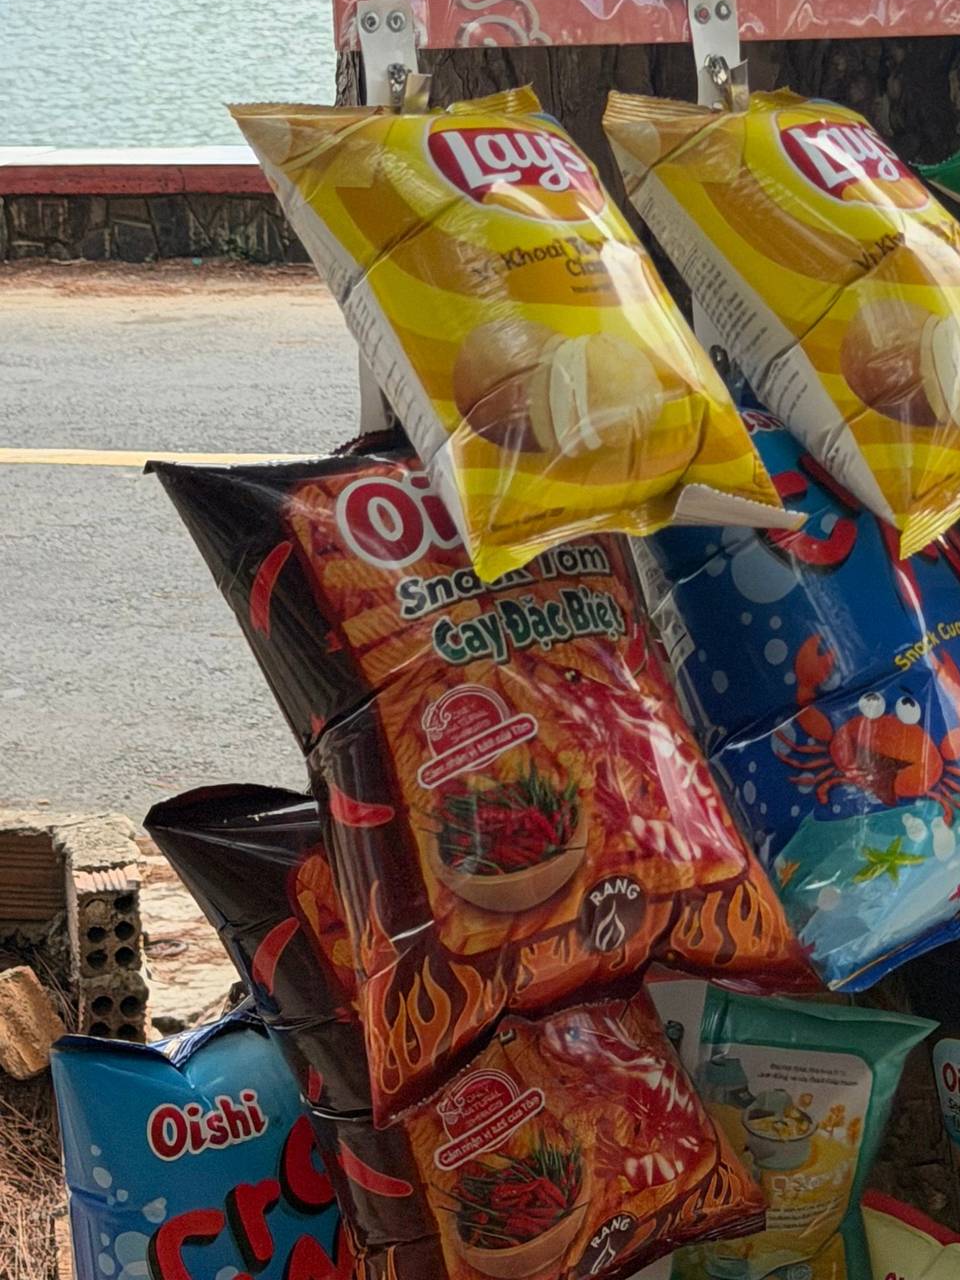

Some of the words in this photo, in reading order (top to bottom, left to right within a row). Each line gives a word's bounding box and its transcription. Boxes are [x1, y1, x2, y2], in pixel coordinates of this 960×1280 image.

[442, 130, 588, 192] Lay's
[432, 611, 509, 665] Cay
[496, 595, 573, 652] Đặc
[558, 585, 627, 642] Biệt
[589, 878, 641, 907] RANG
[147, 1088, 269, 1162] Oishi
[589, 1215, 633, 1250] RANG
